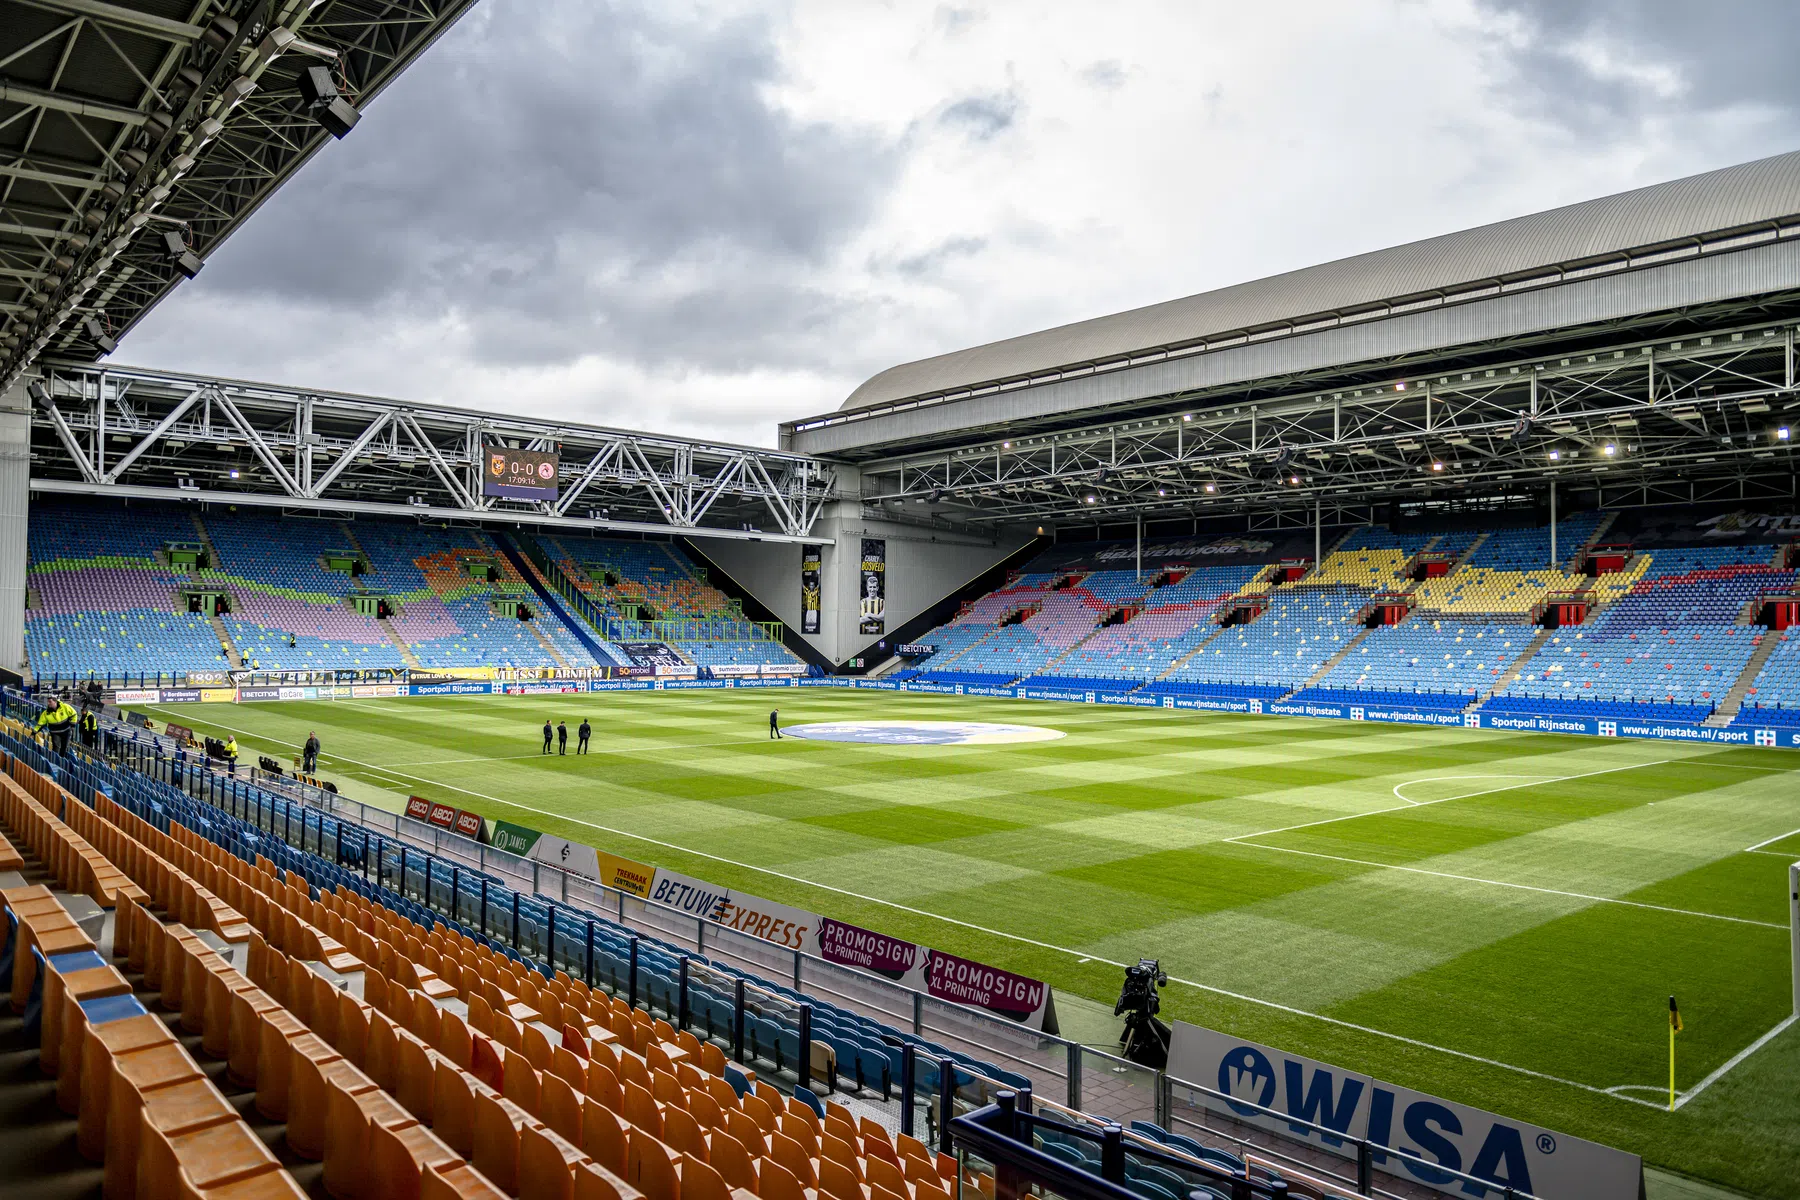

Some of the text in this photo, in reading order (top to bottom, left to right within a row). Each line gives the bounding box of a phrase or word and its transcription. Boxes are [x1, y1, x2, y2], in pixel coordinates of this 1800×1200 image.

[1187, 545, 1242, 555] MORE
[861, 562, 885, 572] BOSVELD
[188, 673, 223, 685] 1892
[494, 669, 541, 680] VITESSE
[555, 668, 602, 679] ARNHEM
[593, 682, 620, 690] Sportpoli
[667, 680, 723, 688] www.rijnstate.nl/sport
[800, 678, 849, 686] www.rijnstate.nl/sport
[877, 681, 896, 689] Rijnstate
[318, 687, 351, 695] bet365
[418, 685, 484, 694] Sportpoli Rijnstate
[908, 684, 954, 693] www.rijnstate.nl/sport
[968, 686, 1012, 696] Sportpoli Rijnstate
[1028, 691, 1083, 700] www.rijnstate.nl/sport
[1101, 694, 1156, 705] Sportpoli Rijnstate
[1177, 699, 1247, 711] www.rijnstate.nl/sport
[1270, 705, 1341, 716] Sportpoli Rijnstate
[1368, 711, 1460, 724] www.rijnstate.nl/sport
[1491, 717, 1586, 731] Sportpoli Rijnstate
[1622, 725, 1748, 741] www.rijnstate.nl/sport
[409, 800, 428, 814] ABCO
[431, 807, 454, 822] ABCO
[458, 814, 479, 831] ABCO
[508, 834, 527, 850] JAMES
[617, 868, 647, 885] TREKHAAK
[826, 923, 915, 966] PROMOSIGN
[823, 941, 873, 966] XL PRINTING
[933, 957, 1042, 1007] PROMOSIGN
[930, 976, 942, 991] XL
[944, 981, 991, 1006] PRINTING
